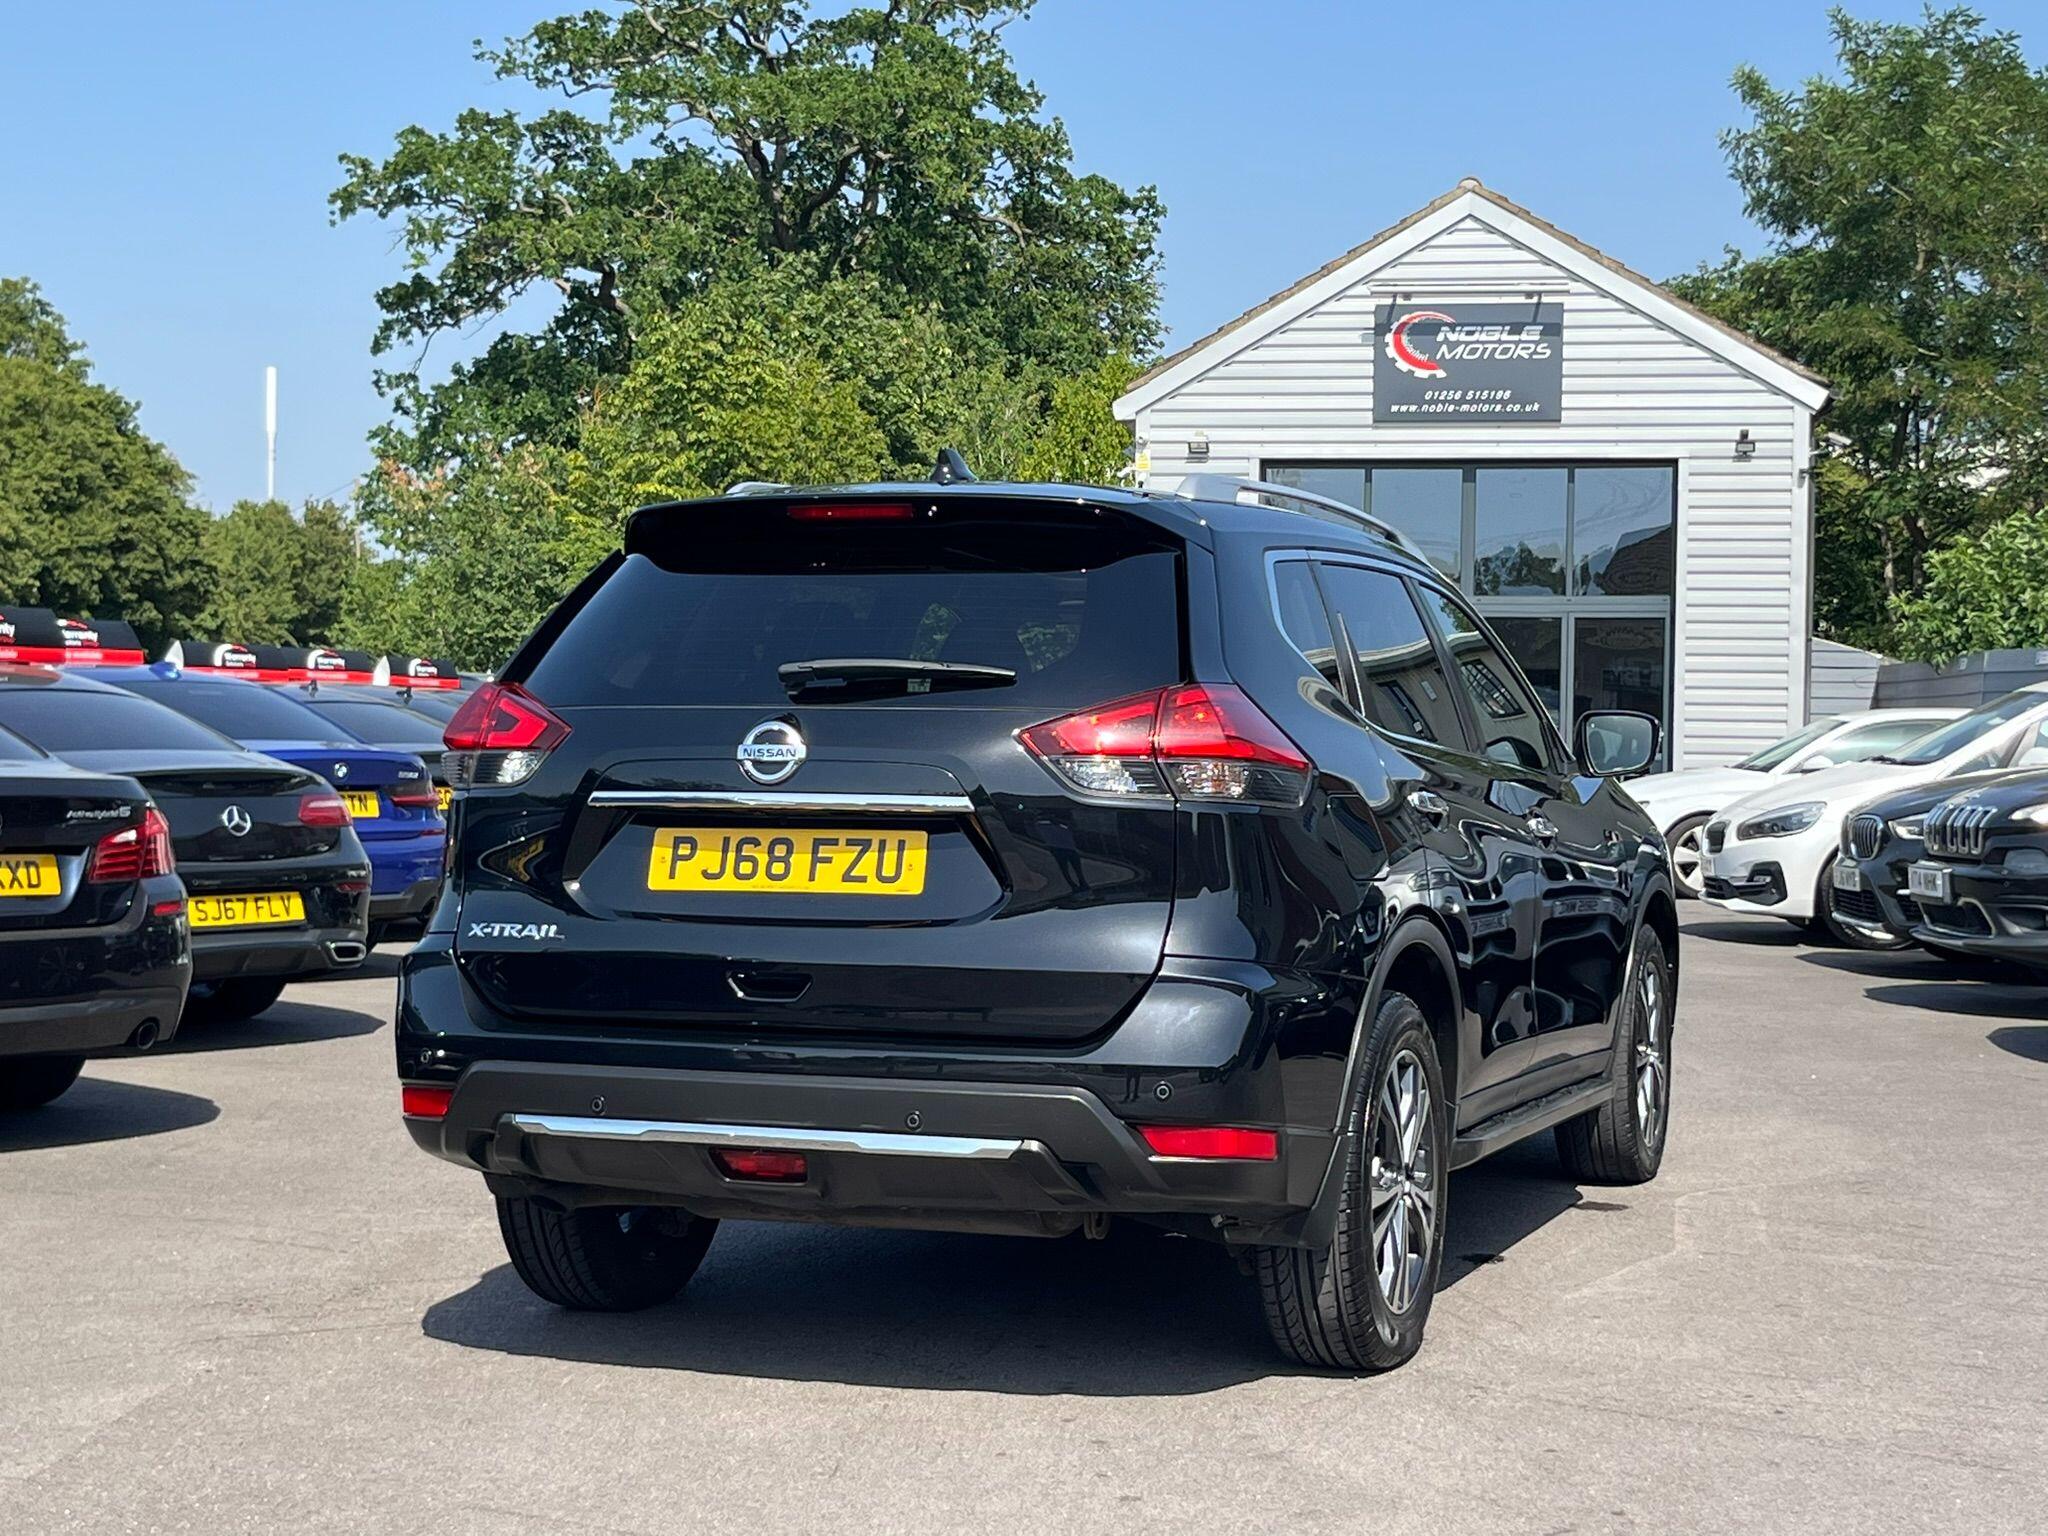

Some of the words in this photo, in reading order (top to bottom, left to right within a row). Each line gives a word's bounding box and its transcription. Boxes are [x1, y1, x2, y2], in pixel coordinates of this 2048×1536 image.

[1435, 325, 1544, 342] NOBLE
[1435, 343, 1552, 360] MOTORS
[1424, 390, 1463, 400] 01256
[1390, 402, 1541, 413] www.noble-motors.co.uk
[742, 747, 797, 758] NISSAN
[668, 836, 794, 882] PJ68
[808, 838, 907, 884] FZU
[194, 897, 247, 922] SJ67
[255, 895, 292, 919] FLV
[467, 922, 567, 940] X-TRAIL
